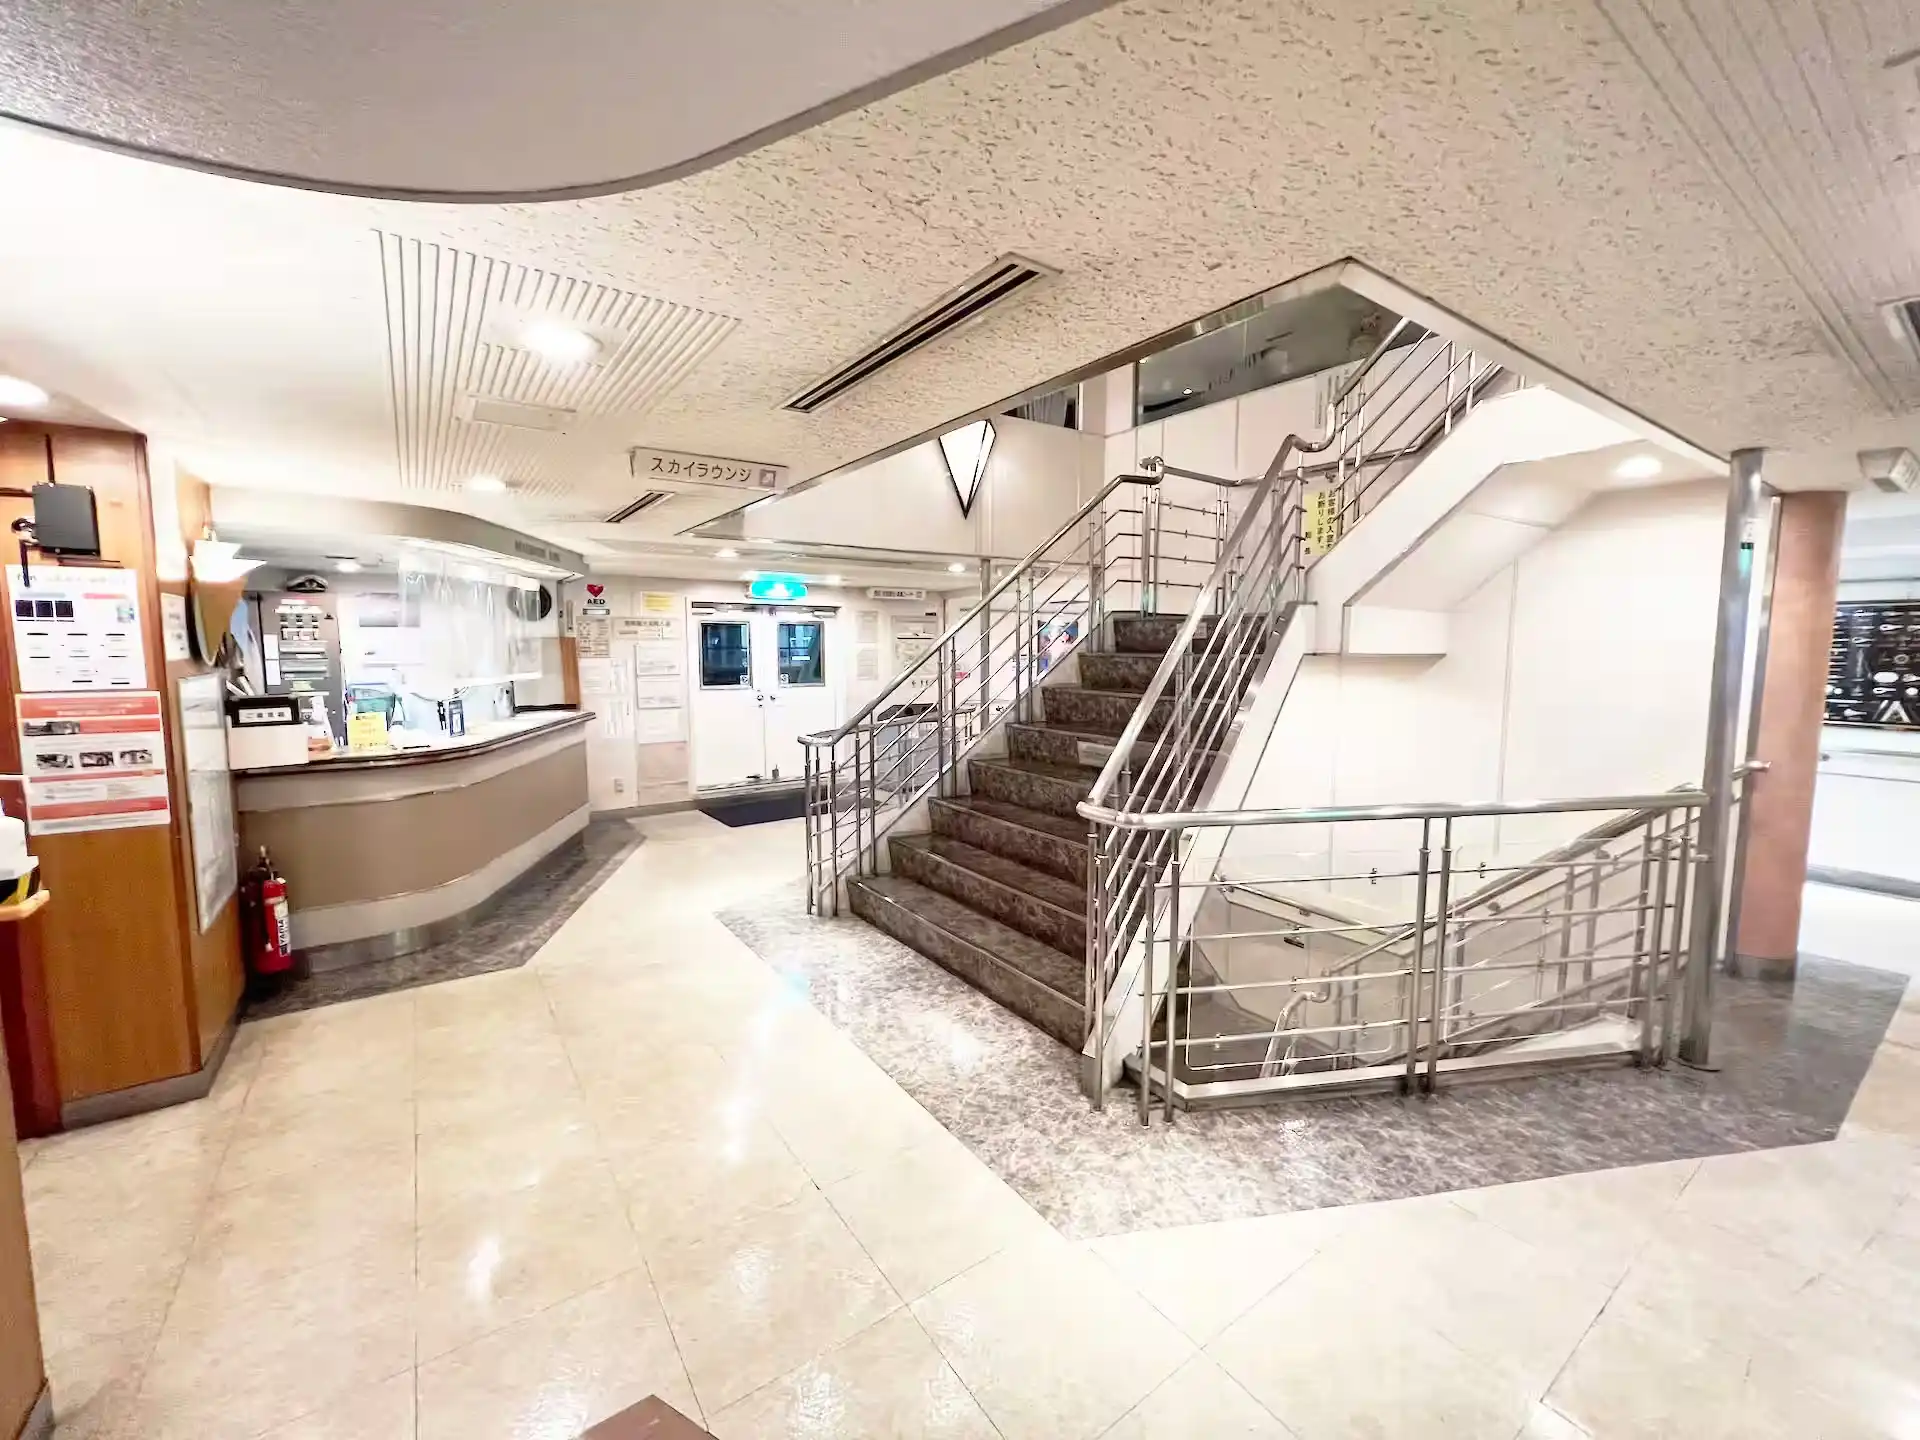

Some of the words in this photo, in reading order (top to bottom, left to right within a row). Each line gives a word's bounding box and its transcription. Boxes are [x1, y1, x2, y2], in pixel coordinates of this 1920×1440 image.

[651, 457, 752, 482] スカイラウンジ
